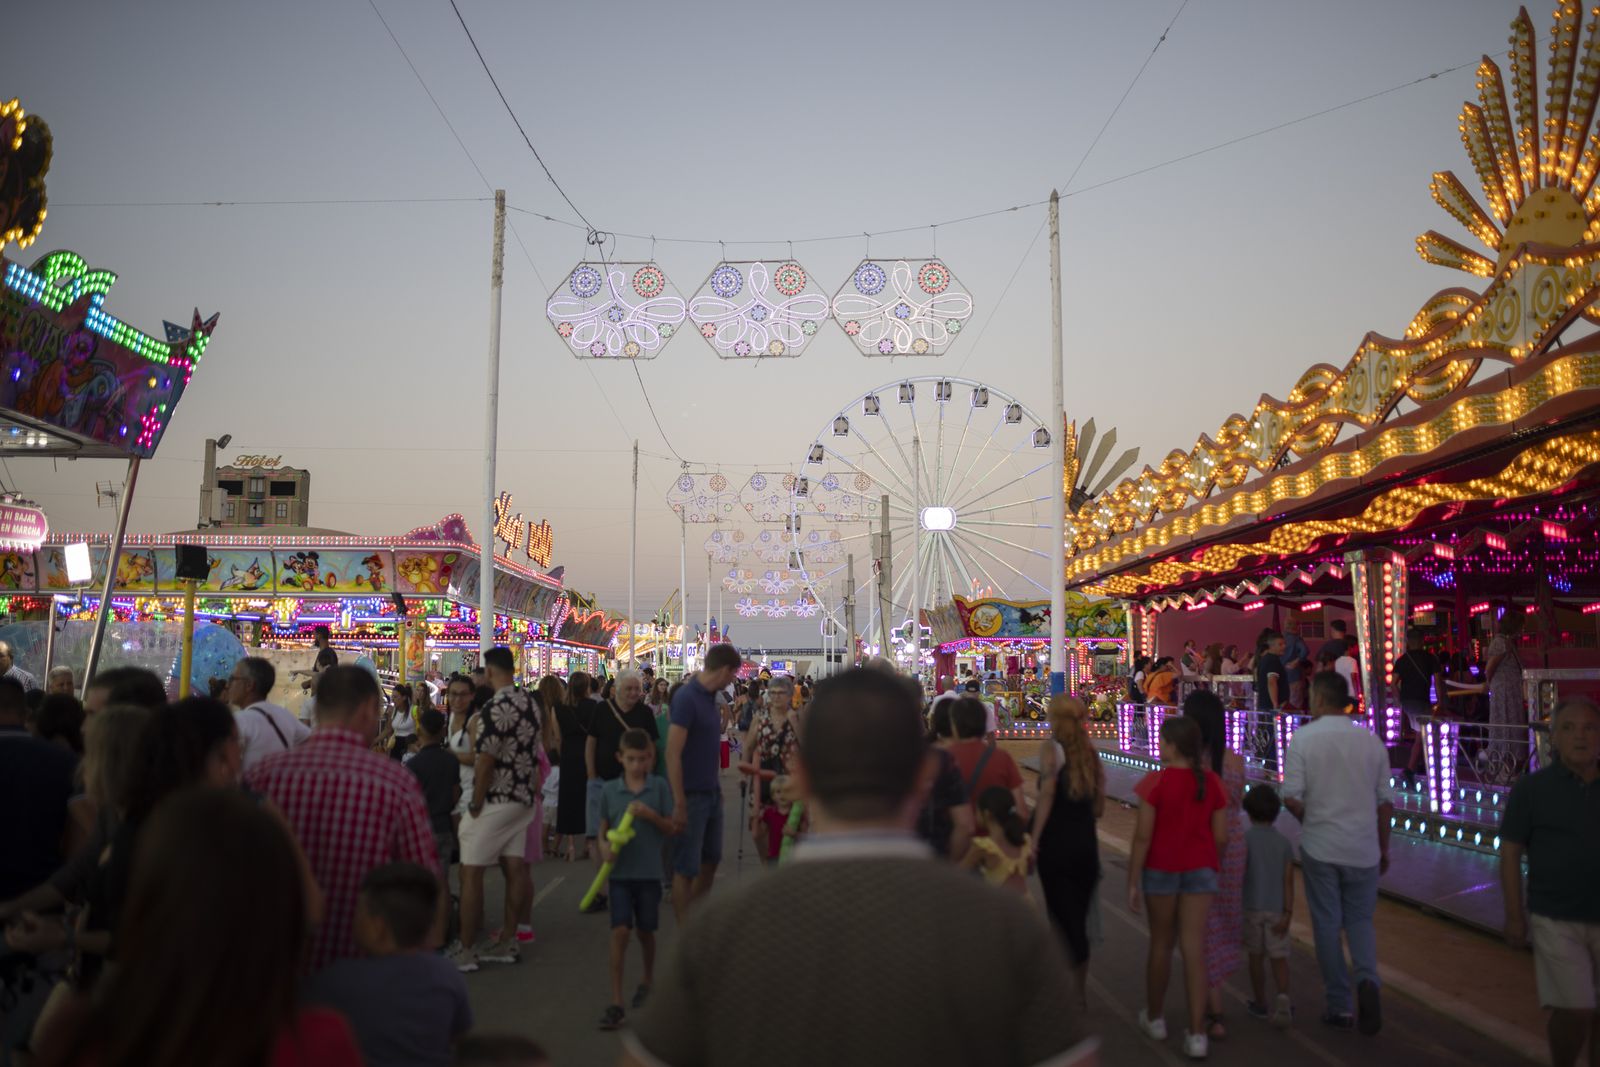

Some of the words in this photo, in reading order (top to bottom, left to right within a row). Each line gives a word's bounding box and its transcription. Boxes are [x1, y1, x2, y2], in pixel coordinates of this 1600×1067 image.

[233, 455, 282, 466] Hotel
[4, 511, 13, 521] NI
[14, 512, 37, 524] BAJAR
[1, 523, 11, 533] EN
[12, 524, 41, 537] MARCHA
